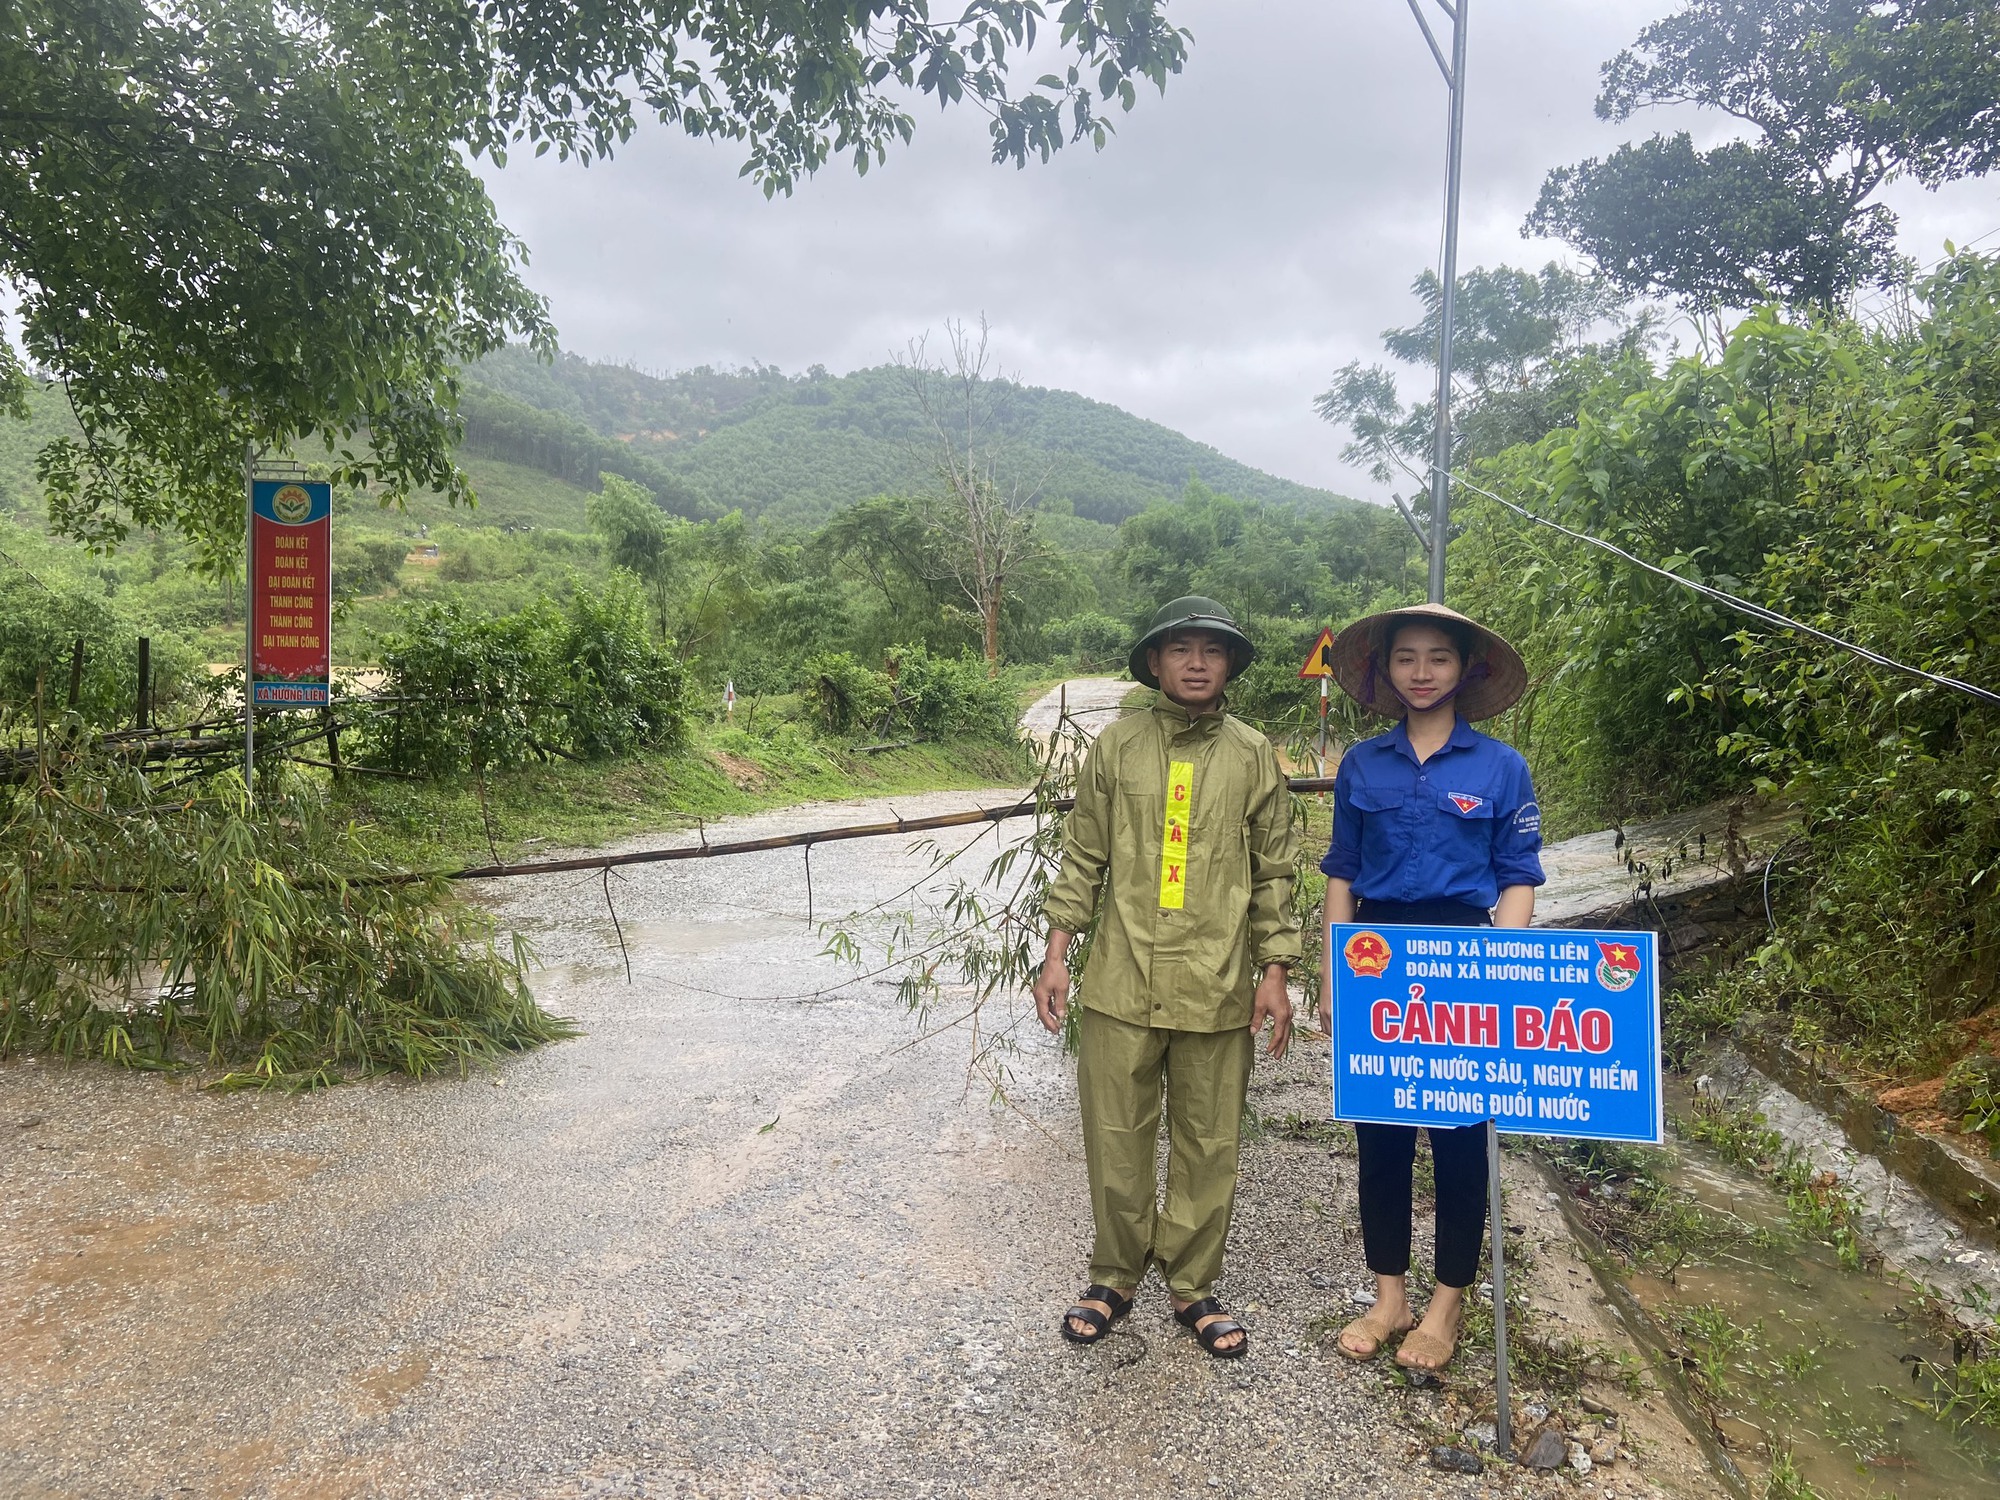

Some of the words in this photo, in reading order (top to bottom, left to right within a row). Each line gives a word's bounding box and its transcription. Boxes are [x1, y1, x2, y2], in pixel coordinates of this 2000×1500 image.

[275, 533, 295, 549] ĐOÀN
[296, 532, 309, 549] KẾT
[275, 553, 295, 569] ĐOÀN
[296, 552, 309, 569] KẾT
[268, 575, 281, 590] ĐẠI
[281, 573, 301, 589] ĐOÀN
[302, 572, 316, 589] KẾT
[270, 593, 293, 608] THÀNH
[294, 594, 313, 609] CÔNG
[270, 613, 293, 628] THÀNH
[294, 613, 313, 629] CÔNG
[263, 634, 275, 650] ĐẠI
[276, 633, 299, 648] THÀNH
[300, 633, 320, 649] CÔNG
[1405, 939, 1453, 956] UBND
[1457, 938, 1481, 957] XÃ
[1485, 941, 1545, 960] HƯƠNG
[1550, 941, 1589, 961] LIÊN
[1405, 959, 1453, 978] ĐOÀN
[1457, 960, 1481, 980] XÃ
[1485, 963, 1545, 982] HƯƠNG
[1550, 964, 1589, 984] LIÊN
[1370, 983, 1500, 1048] CẢNH
[1513, 998, 1613, 1054] BÁO
[1349, 1053, 1385, 1076] KHU
[1389, 1054, 1425, 1082] VỰC
[1429, 1053, 1480, 1081] NƯỚC
[1484, 1057, 1528, 1088] SÂU,
[1533, 1063, 1584, 1088] NGUY
[1589, 1059, 1639, 1092] HIỂM
[1393, 1081, 1417, 1110] ĐỀ
[1422, 1085, 1484, 1115] PHÒNG
[1488, 1088, 1533, 1118] ĐUỐI
[1538, 1092, 1591, 1122] NƯỚC
